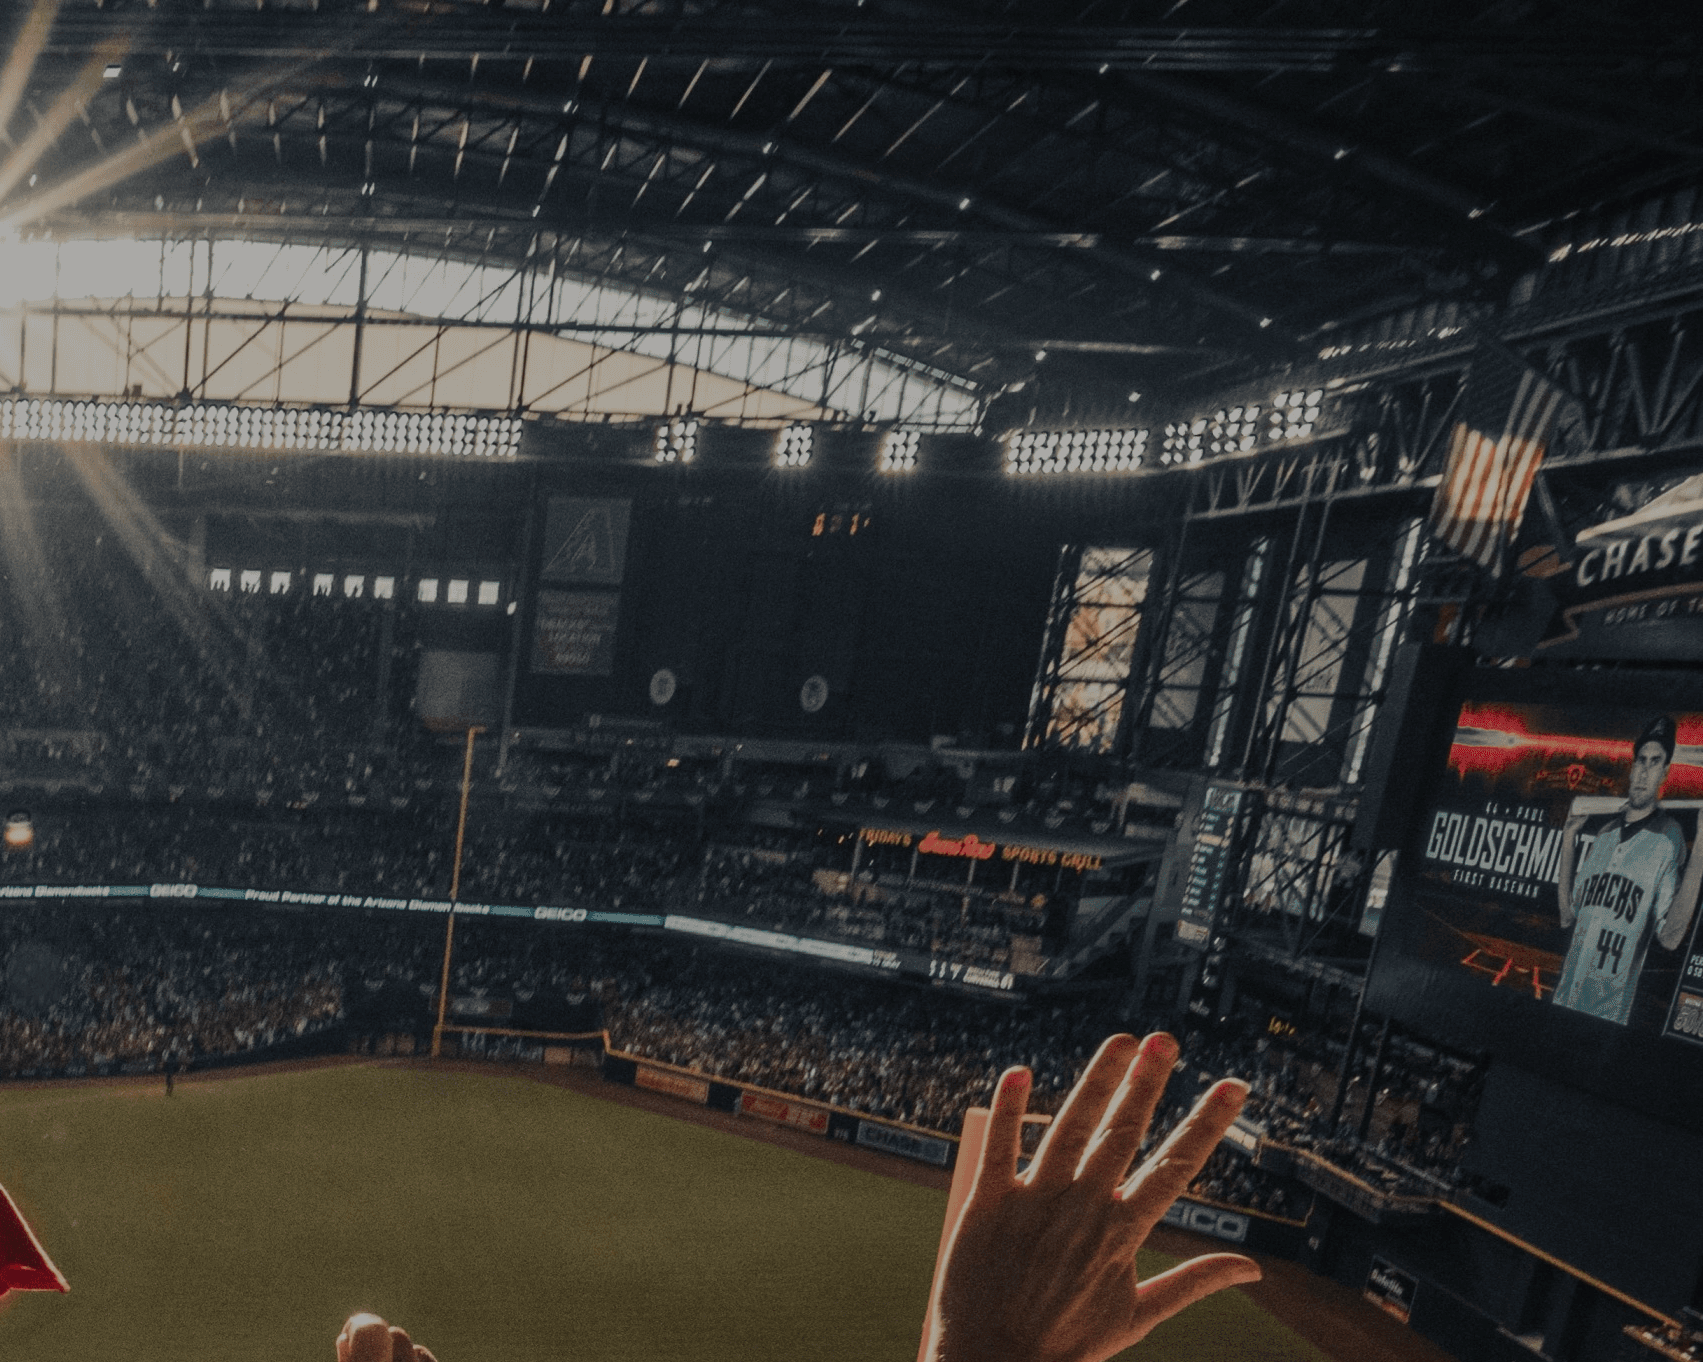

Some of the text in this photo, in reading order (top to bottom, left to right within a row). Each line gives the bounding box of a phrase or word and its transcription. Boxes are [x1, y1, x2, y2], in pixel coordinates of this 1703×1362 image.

[1576, 524, 1703, 587] CHASE
[1656, 599, 1677, 617] OF
[1516, 806, 1545, 822] PAUL
[1426, 810, 1596, 884] GOLDSCHMIT
[150, 883, 198, 898] GEICO
[1453, 869, 1540, 898] FIRST BASEMAN
[244, 889, 280, 902] Proud
[281, 890, 327, 905] Partner
[363, 896, 408, 911] Arizona
[408, 899, 490, 915] Diamonbacks
[534, 906, 588, 922] GEICO
[1597, 929, 1626, 974] 44
[1162, 1200, 1245, 1239] EICO
